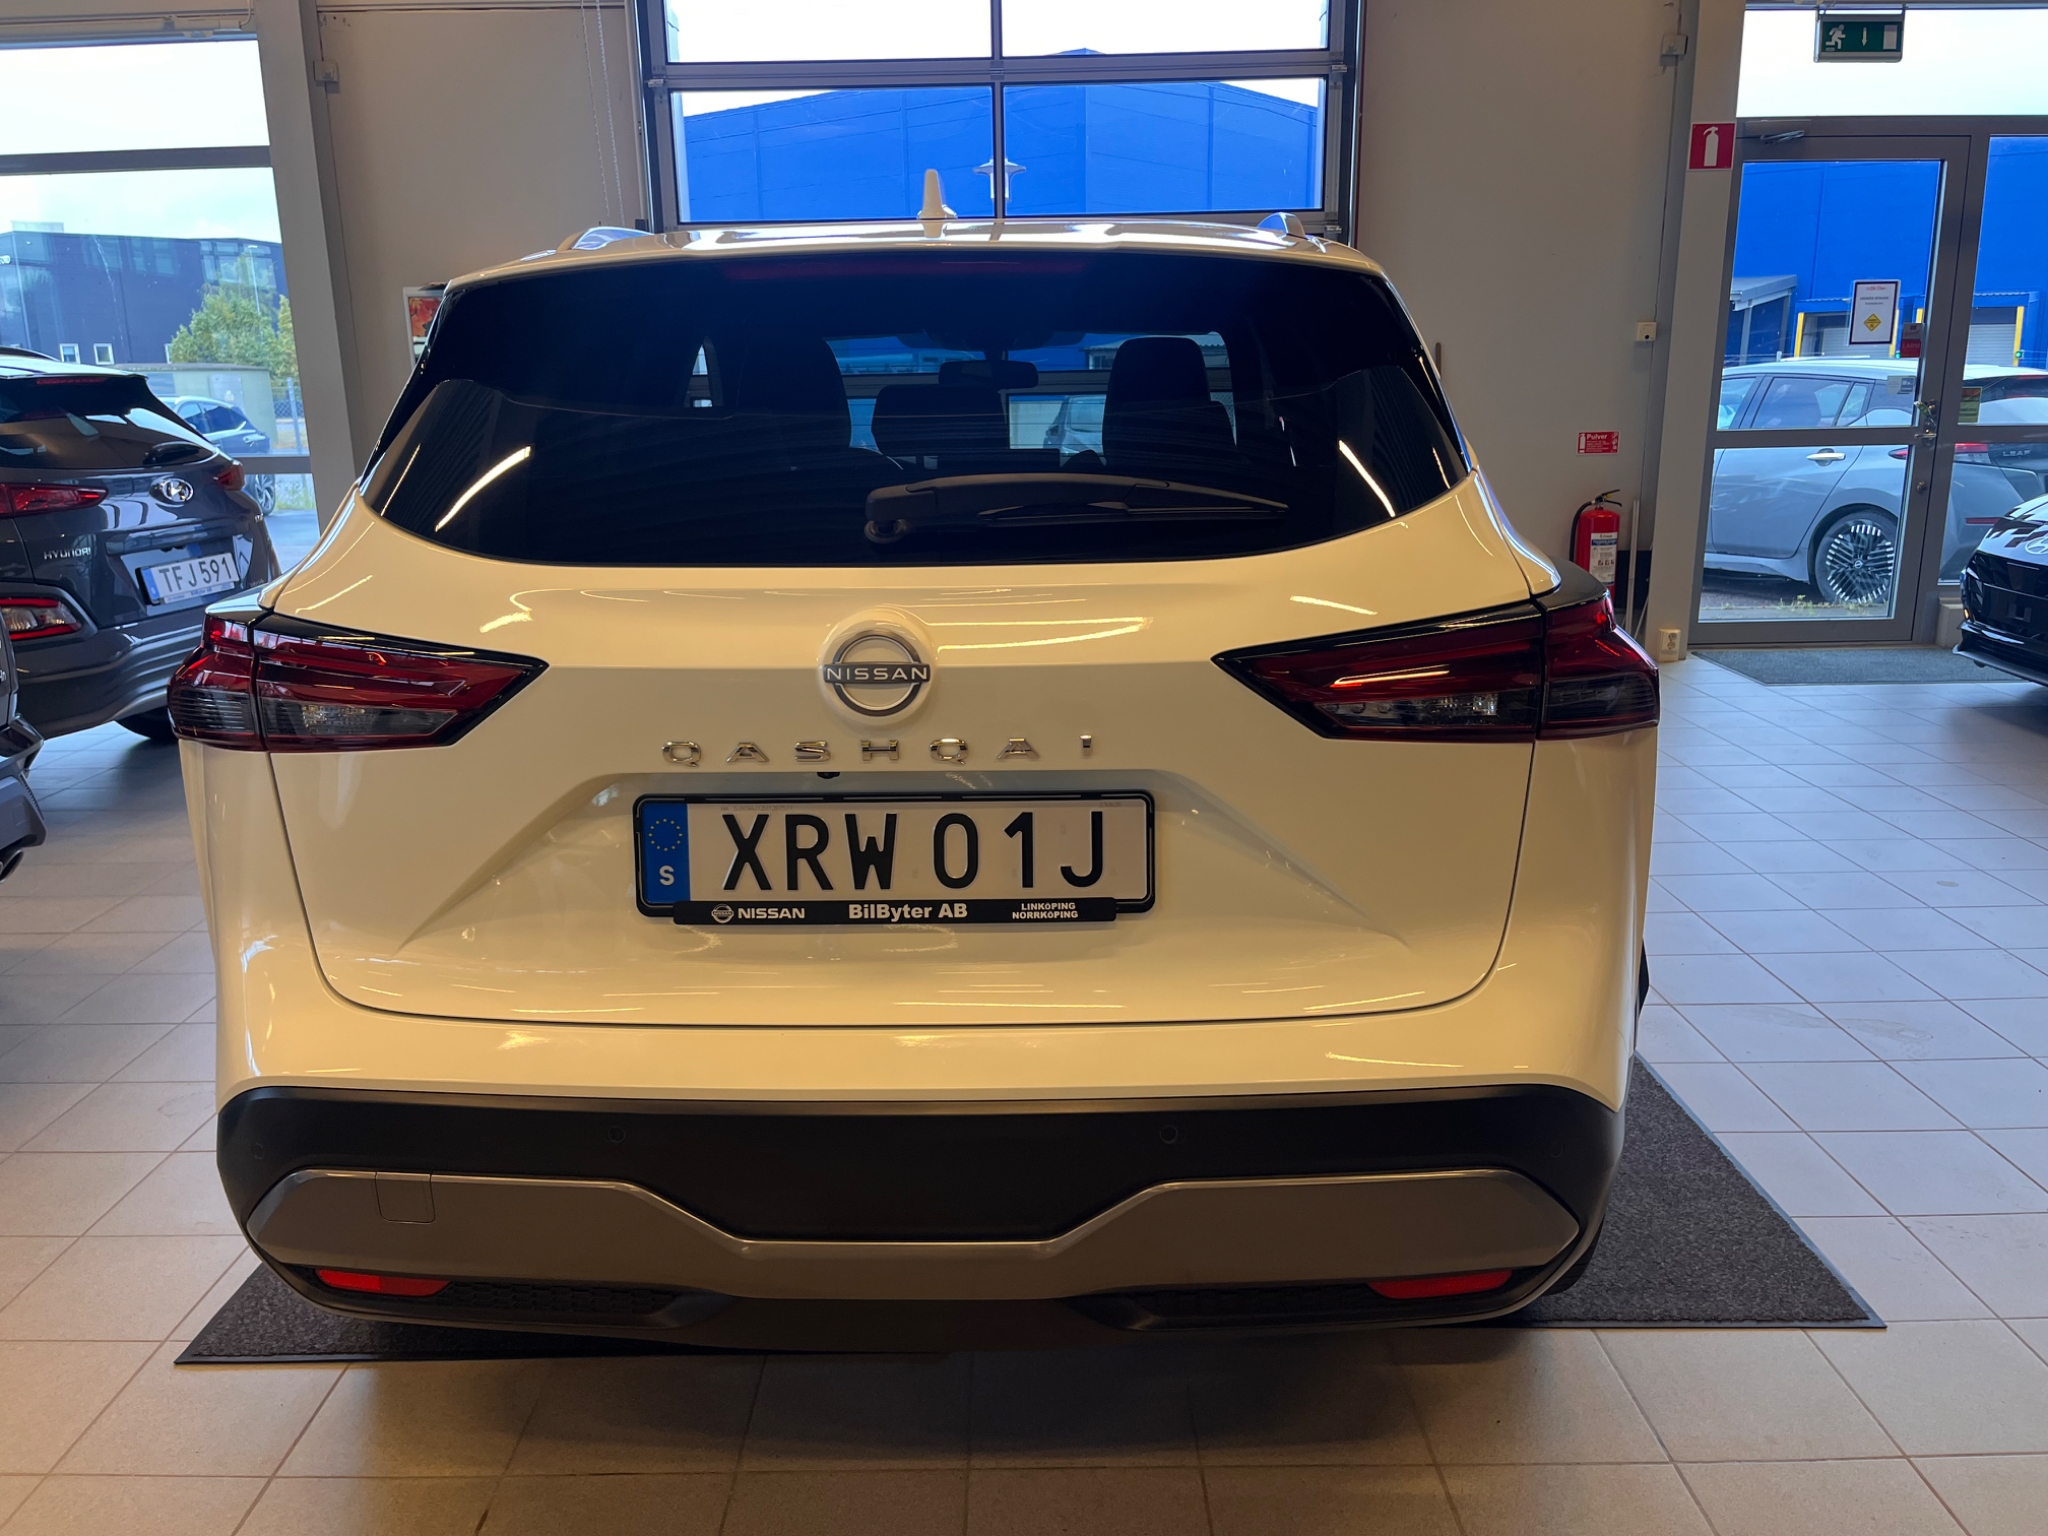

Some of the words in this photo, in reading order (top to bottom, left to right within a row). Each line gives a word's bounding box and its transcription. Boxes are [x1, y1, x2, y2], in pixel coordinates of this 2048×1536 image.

[44, 547, 91, 560] HYUNDAI
[827, 667, 928, 681] NISSAN
[661, 734, 1093, 768] QASHQAI
[721, 813, 898, 891] XRW
[659, 865, 675, 886] S
[738, 907, 805, 919] NISSAN
[849, 904, 932, 922] BilByter
[938, 903, 968, 918] AB
